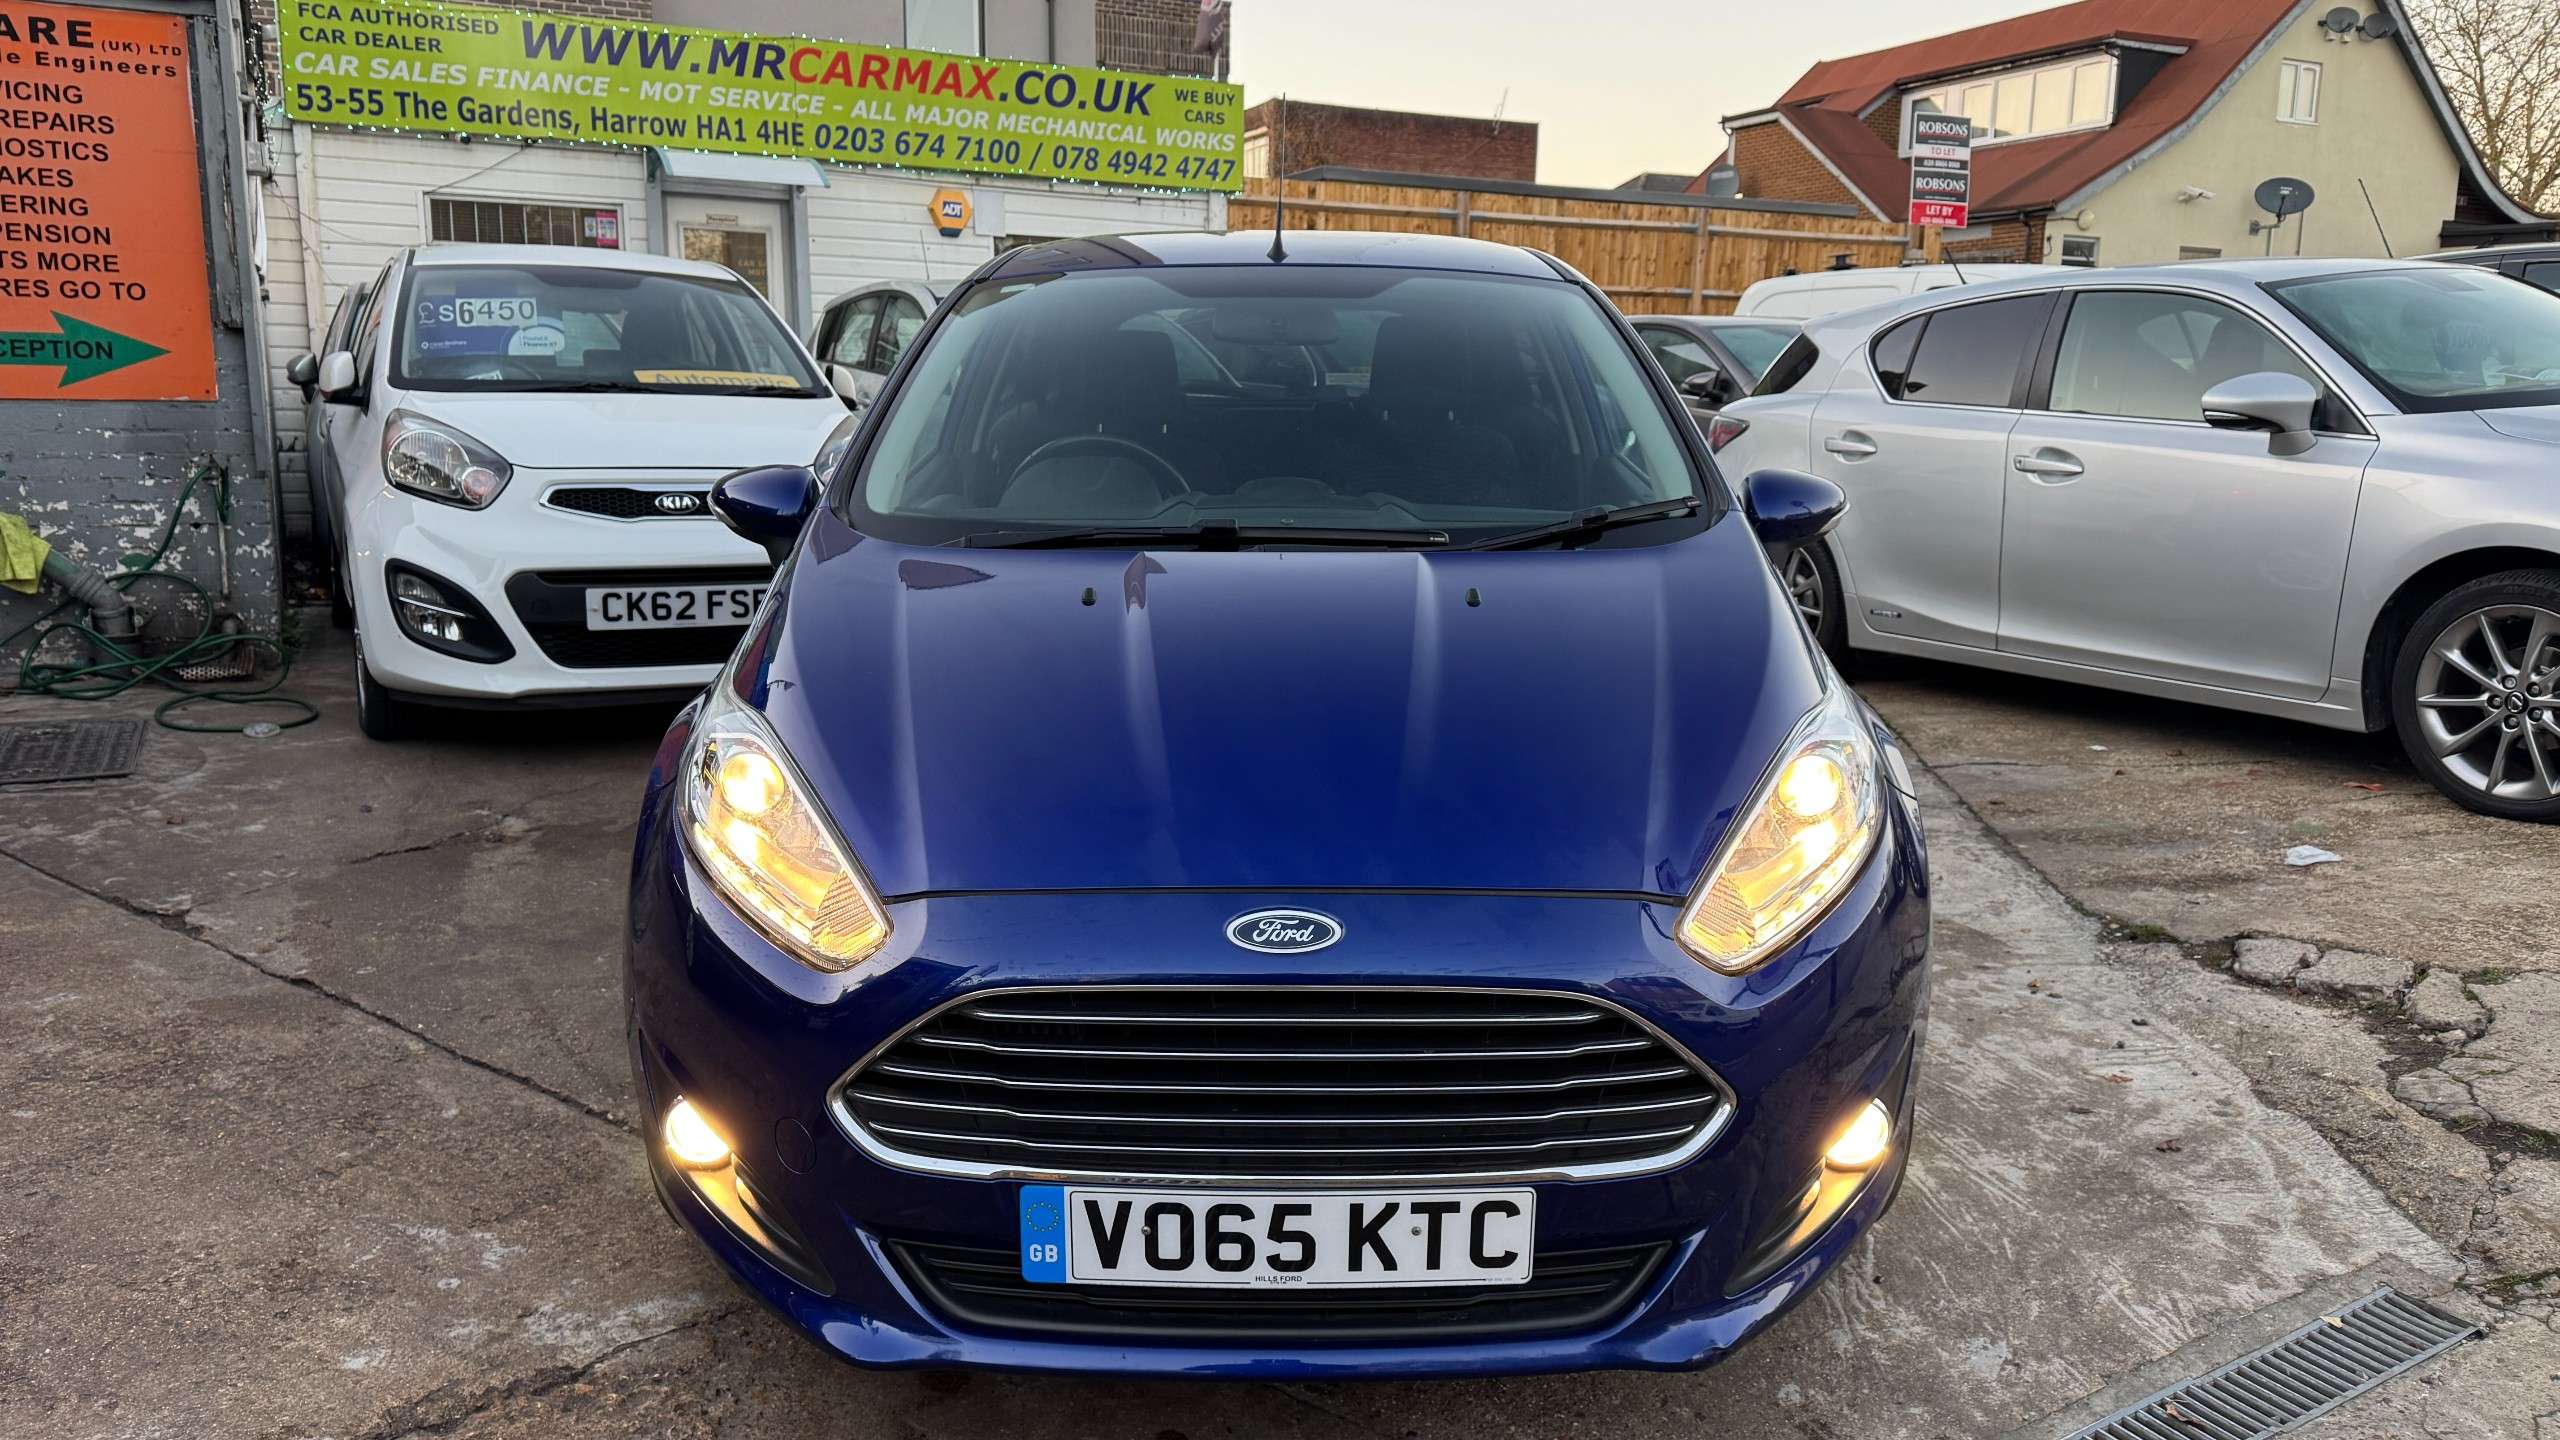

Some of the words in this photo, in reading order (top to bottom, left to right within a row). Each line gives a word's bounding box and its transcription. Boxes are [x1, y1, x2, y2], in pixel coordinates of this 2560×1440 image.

[298, 3, 342, 21] FCA
[350, 7, 499, 36] AUTHORISED
[101, 39, 141, 56] (UK)
[149, 44, 182, 56] LTD
[300, 26, 347, 45] CAR
[355, 31, 443, 53] DEALER
[35, 51, 176, 77] Engineers
[522, 20, 1155, 117] WWW.MRCARMAX.CO.UK
[0, 79, 83, 104] ICING
[294, 51, 360, 77] CAR
[368, 57, 467, 86] SALES
[476, 67, 609, 97] FINANCE
[640, 84, 702, 104] MOT
[709, 89, 825, 117] SERVICE
[851, 99, 895, 122] ALL
[905, 106, 989, 130] MAJOR
[998, 111, 1147, 145] MECHANICAL
[1155, 127, 1236, 153] WORKS
[1174, 88, 1200, 104] WE
[1204, 91, 1236, 107] BUY
[1184, 109, 1225, 126] CARS
[1919, 120, 1968, 136] ROBSONS
[296, 84, 384, 116] 53-55
[393, 90, 448, 120] The
[457, 97, 580, 134] Gardens,
[590, 106, 686, 138] Harrow
[697, 114, 746, 142] HA1
[756, 119, 804, 147] 4HE
[814, 124, 884, 154] 0203
[894, 130, 945, 158] 674
[956, 135, 1020, 164] 7100
[1052, 144, 1099, 172] 078
[1107, 150, 1167, 177] 4942
[1175, 156, 1236, 183] 4747
[0, 138, 109, 162] OSTICS
[1931, 146, 1942, 155] TO
[1943, 147, 1956, 156] LET
[0, 166, 73, 187] AKES
[1915, 177, 1966, 192] ROBSONS
[0, 194, 88, 216] ERING
[943, 203, 961, 216] ADT
[1926, 204, 1941, 216] LET
[1942, 205, 1954, 216] BY
[0, 222, 111, 245] ENSION
[37, 251, 120, 273] MORE
[60, 280, 101, 299] GO
[109, 282, 146, 300] TO
[662, 496, 693, 509] KIA
[602, 591, 696, 622] CK62
[1252, 919, 1315, 942] Ford
[1083, 1199, 1316, 1273] VO65
[1348, 1200, 1519, 1273] KTC
[1029, 1243, 1058, 1263] GB
